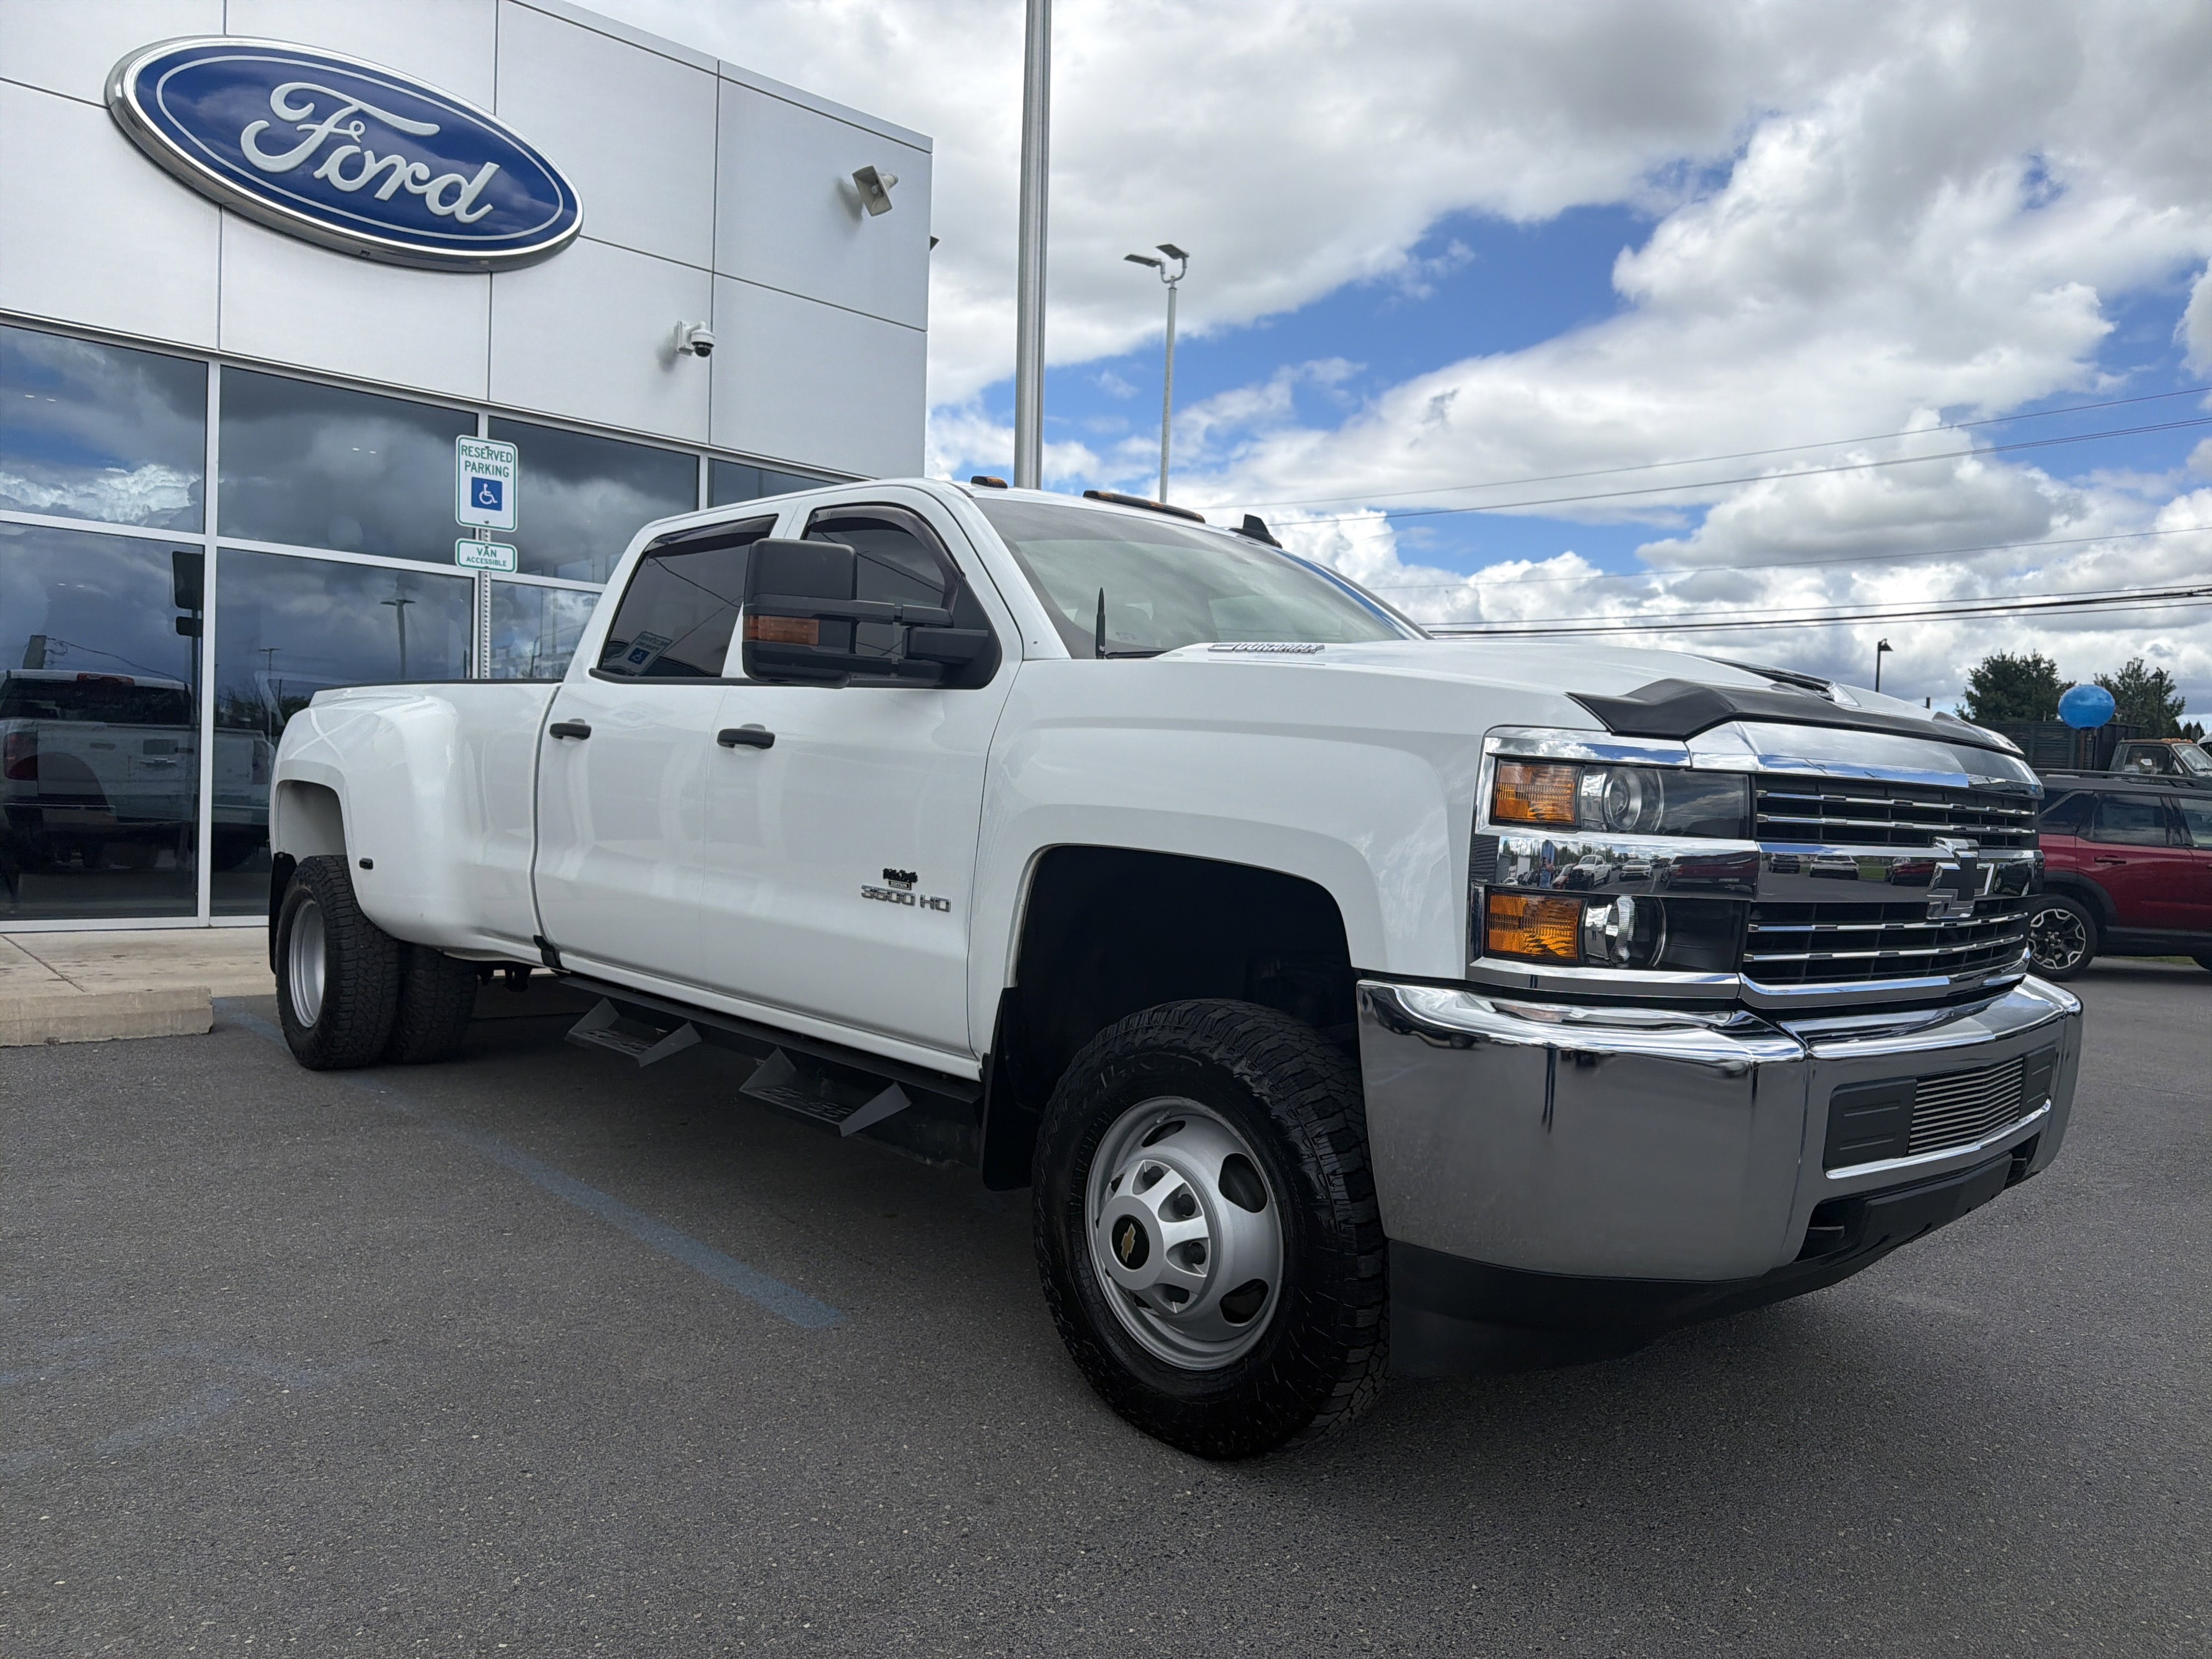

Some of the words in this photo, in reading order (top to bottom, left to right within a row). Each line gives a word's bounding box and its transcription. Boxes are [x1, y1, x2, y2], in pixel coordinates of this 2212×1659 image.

[240, 82, 500, 223] Ford
[461, 444, 512, 463] RESERVED
[465, 460, 510, 477] PARKING
[466, 556, 507, 567] ACCESSIBLE
[476, 547, 497, 558] VAN
[861, 884, 916, 906] 3500
[920, 894, 951, 912] HD
